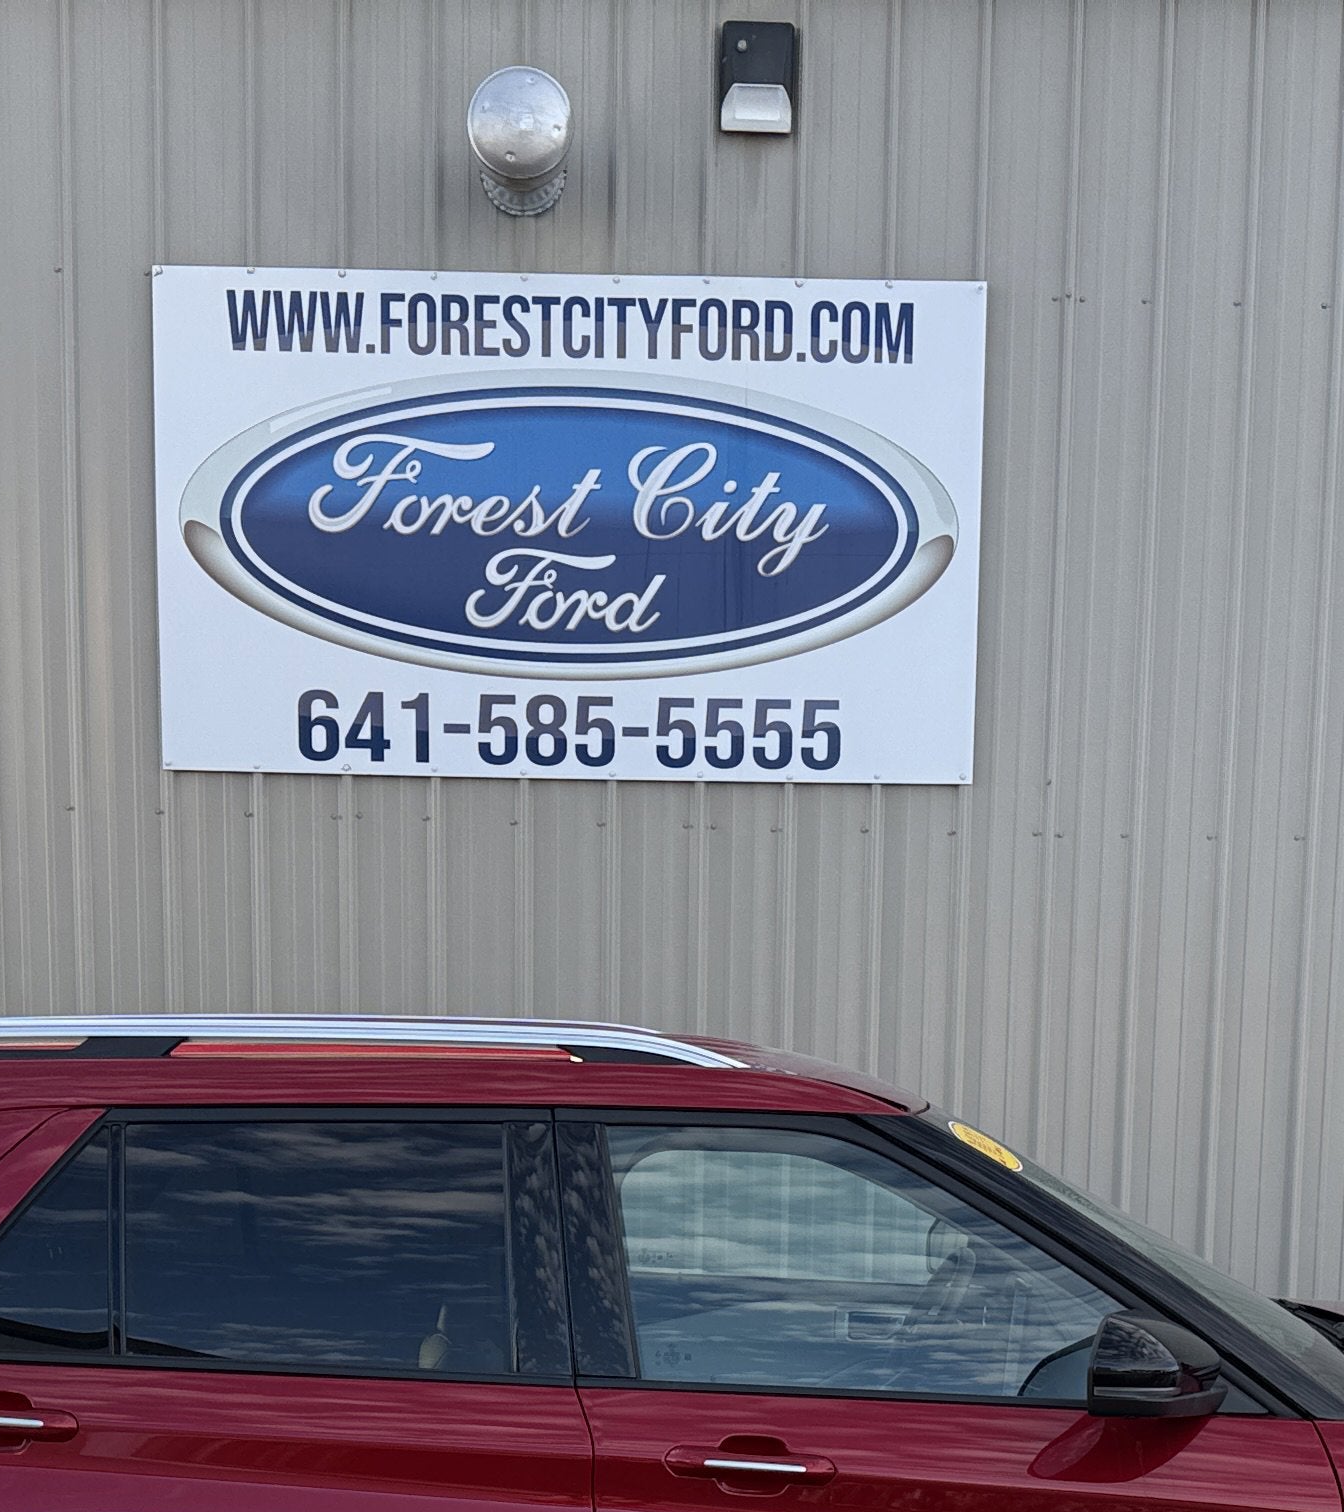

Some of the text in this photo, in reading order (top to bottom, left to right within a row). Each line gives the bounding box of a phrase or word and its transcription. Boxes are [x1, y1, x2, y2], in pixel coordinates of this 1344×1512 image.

[226, 289, 915, 366] WWW.FORESTCITYFORD.COM
[308, 433, 830, 577] Forest City
[464, 547, 667, 632] Ford
[297, 689, 842, 772] 641-585-5555
